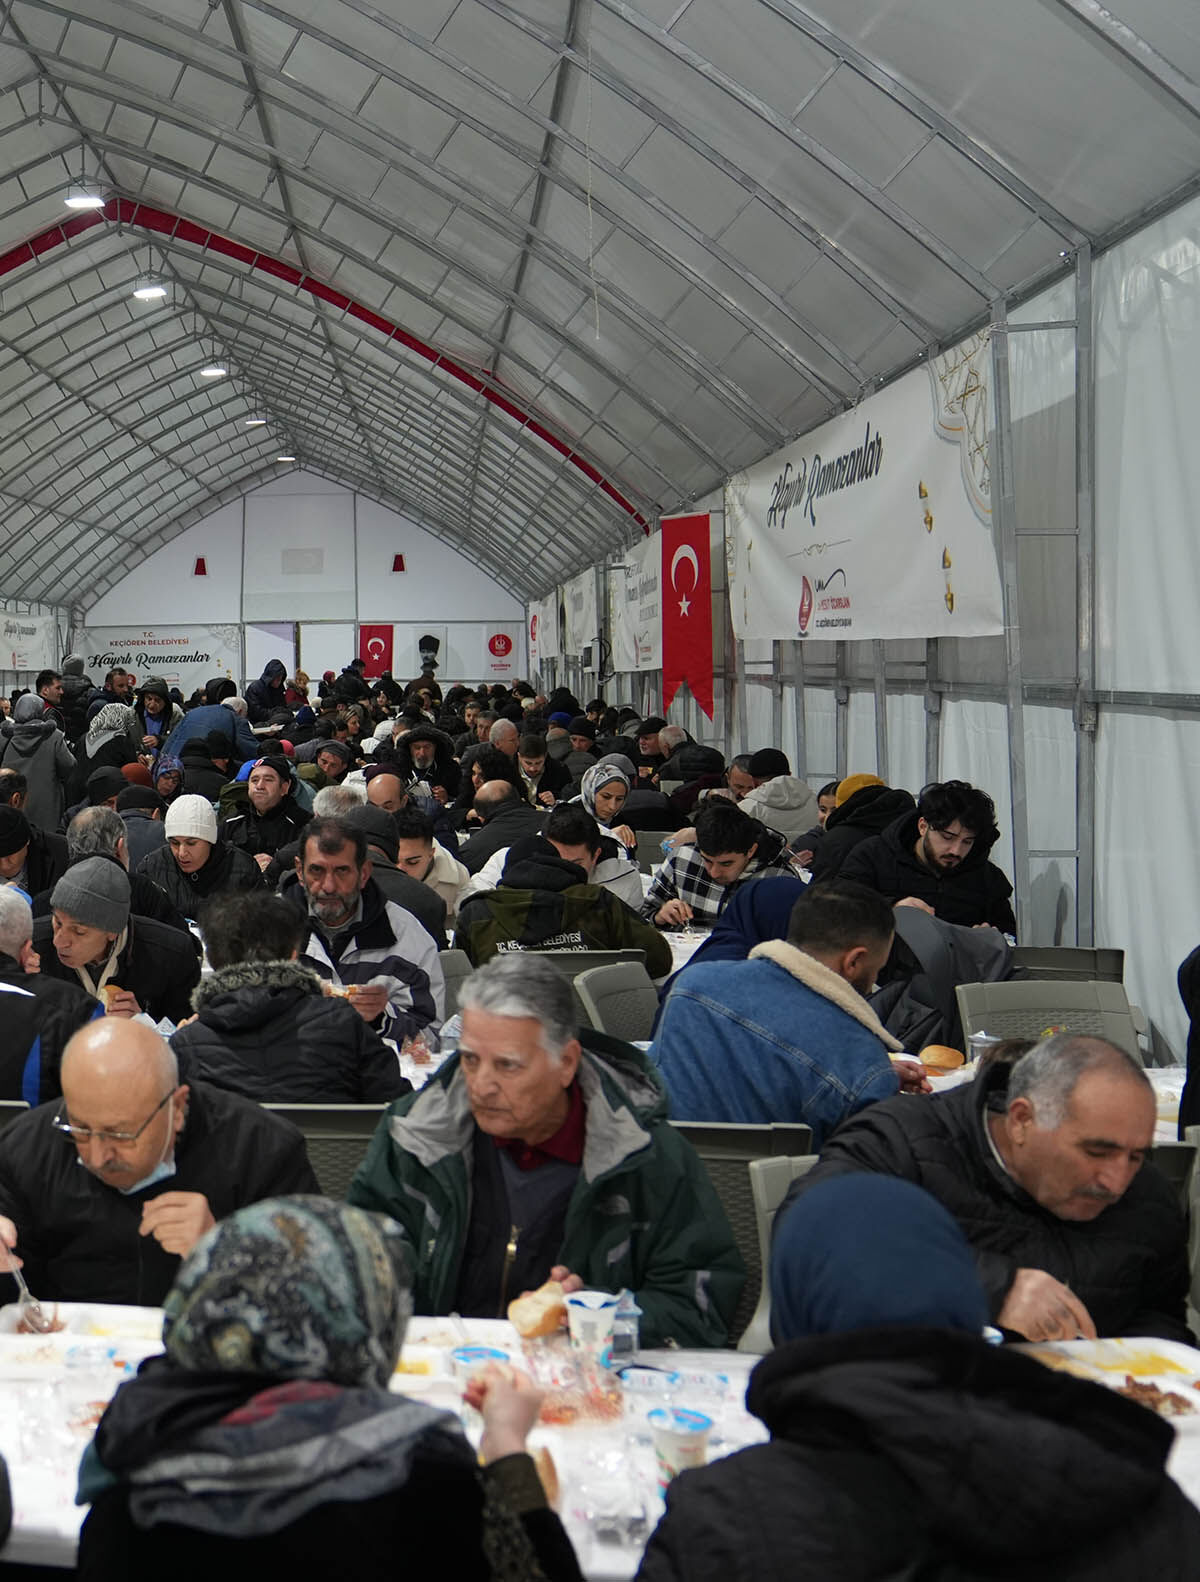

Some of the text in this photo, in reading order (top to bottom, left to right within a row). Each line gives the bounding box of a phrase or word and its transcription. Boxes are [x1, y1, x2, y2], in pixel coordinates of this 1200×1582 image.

[110, 638, 189, 647] KEÇİÖREN BELEDİYESİ
[87, 650, 211, 670] Hayırlı Ramazanlar
